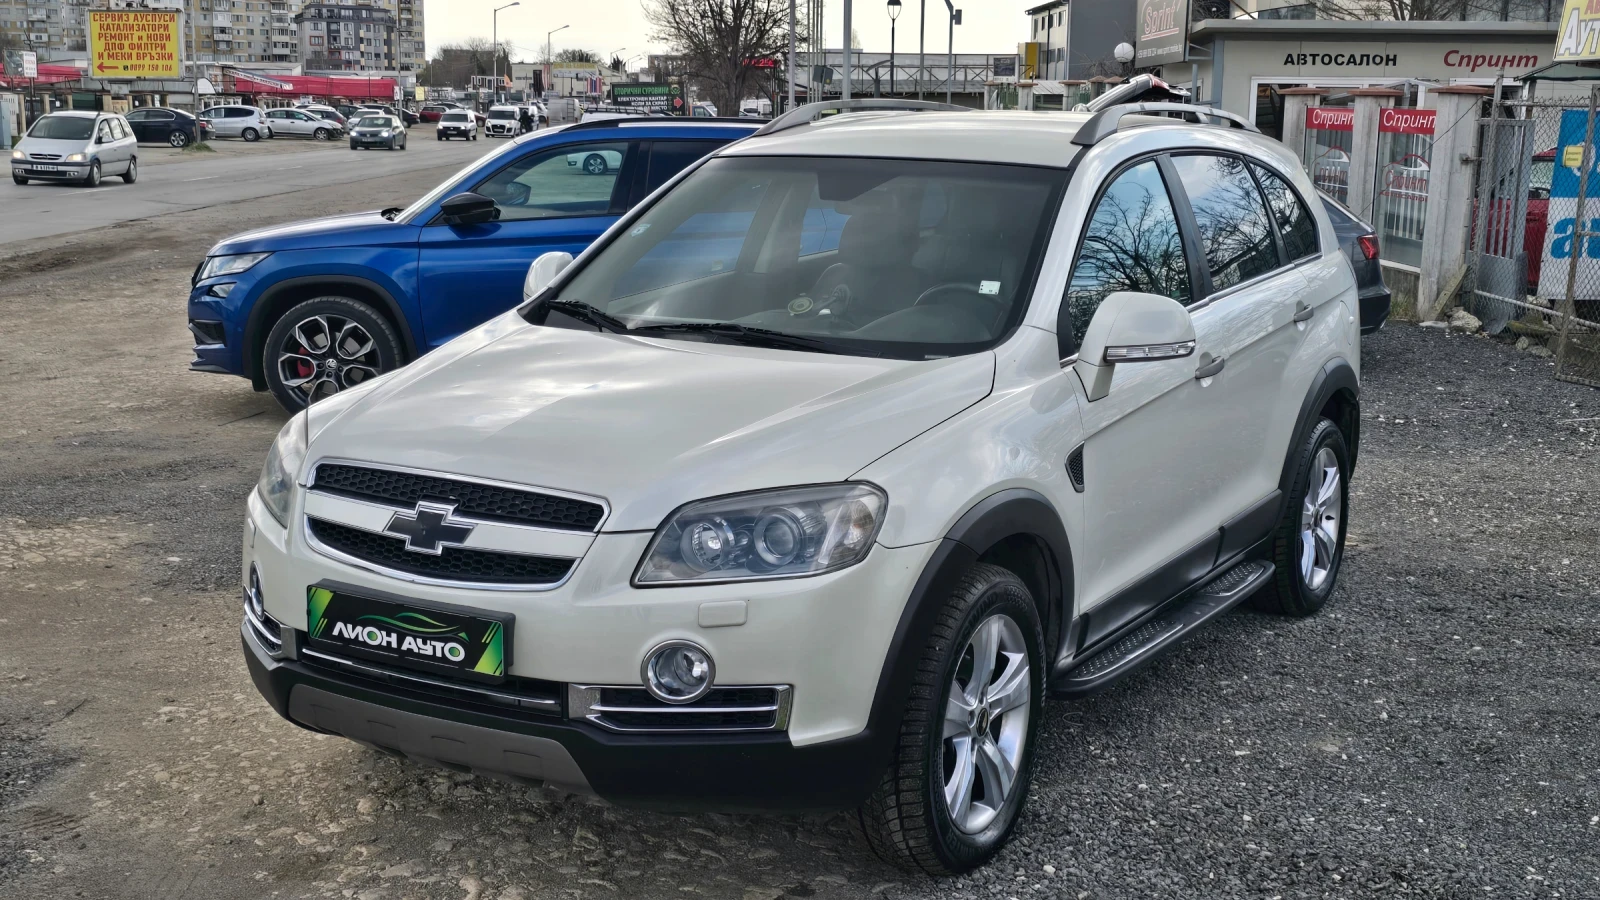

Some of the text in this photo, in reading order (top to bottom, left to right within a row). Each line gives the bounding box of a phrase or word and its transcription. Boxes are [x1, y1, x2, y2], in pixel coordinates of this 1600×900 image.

[92, 13, 175, 22] СЕРВИЗ АУСПУСИ
[1144, 0, 1176, 37] Sprint
[99, 23, 169, 32] КАТАЛИЗАТОРИ
[98, 33, 134, 41] РЕМОНТ
[146, 33, 171, 41] НОВИ
[103, 42, 166, 52] ДПФ ФИЛТРИ
[98, 52, 173, 61] И МЕКИ ВРЪЗКИ
[1283, 53, 1398, 66] АВТОСАЛОН
[1443, 49, 1538, 72] Спринт
[614, 87, 641, 95] ВТОРИЧНИ
[1385, 170, 1427, 192] Спринт
[332, 621, 466, 662] ЛИОН АУТО
